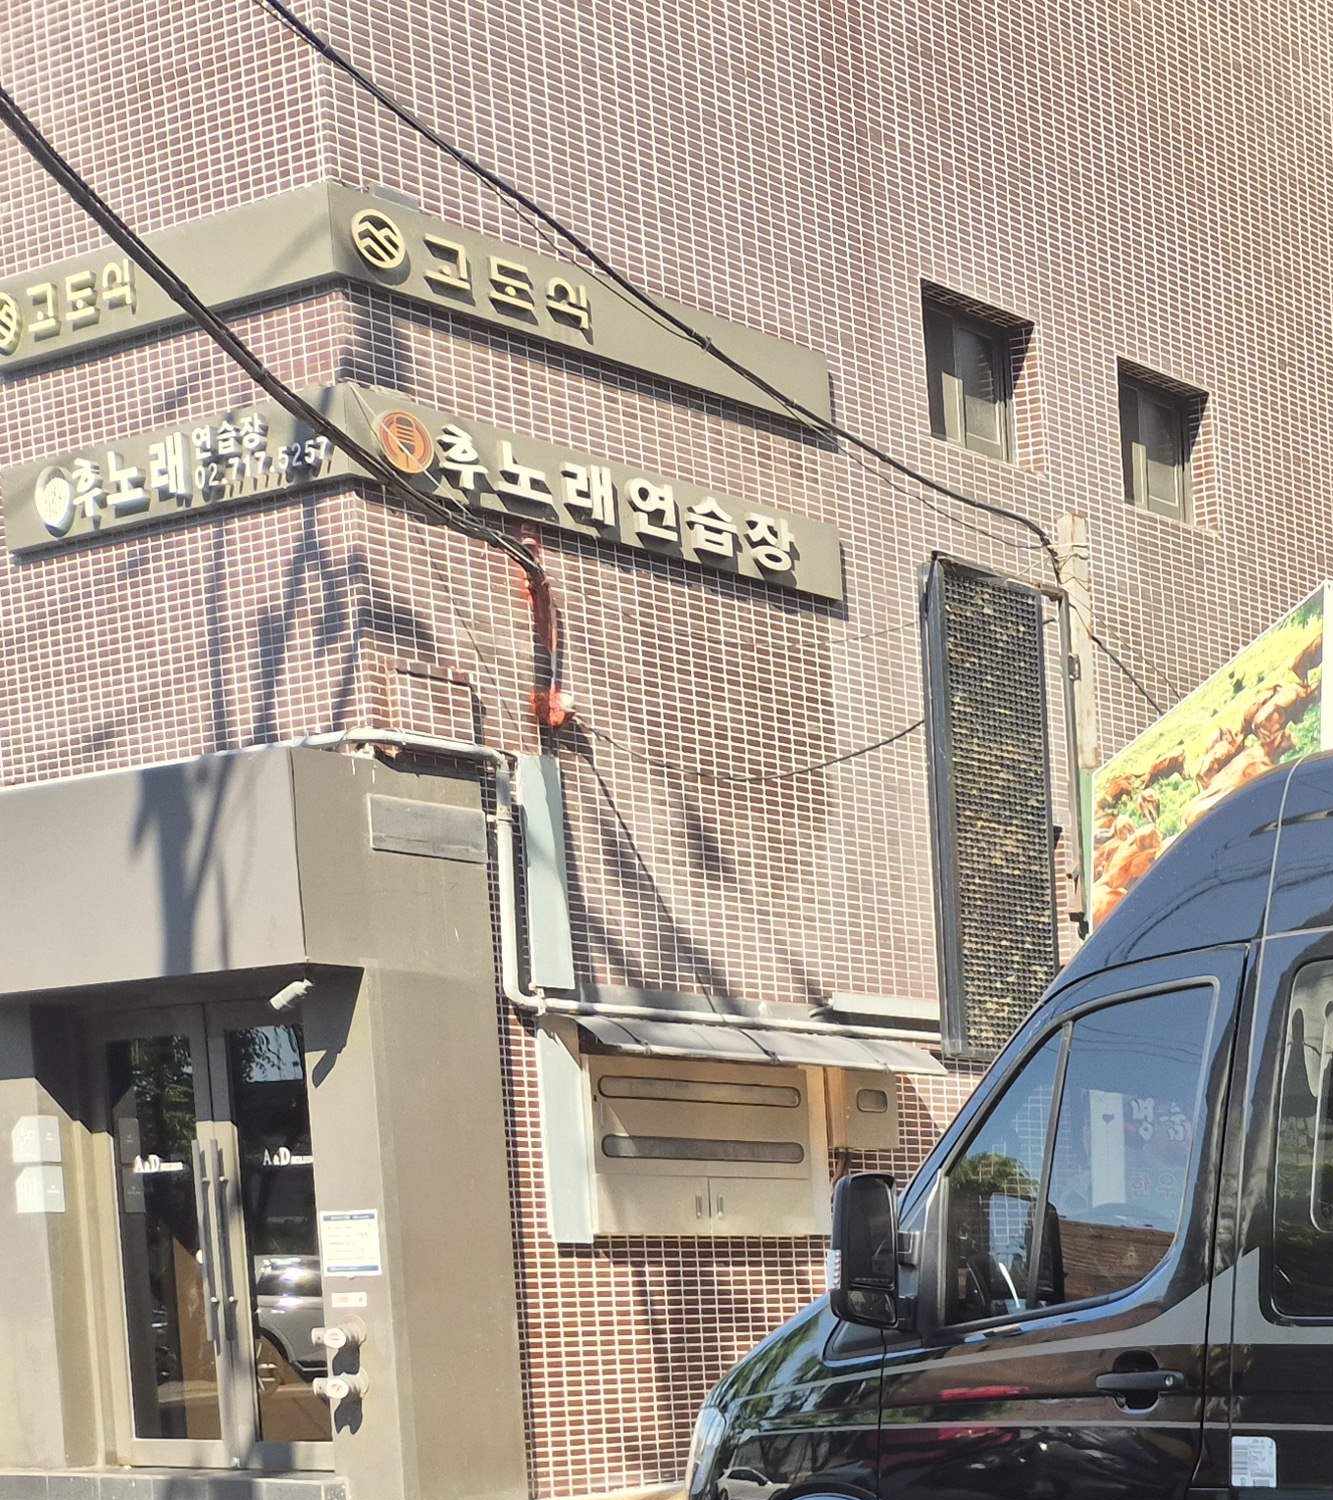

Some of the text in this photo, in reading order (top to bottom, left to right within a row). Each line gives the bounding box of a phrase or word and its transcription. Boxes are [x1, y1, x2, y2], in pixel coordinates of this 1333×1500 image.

[27, 258, 133, 334] 고도식
[424, 233, 591, 331] 고도식
[191, 412, 268, 458] 연습장
